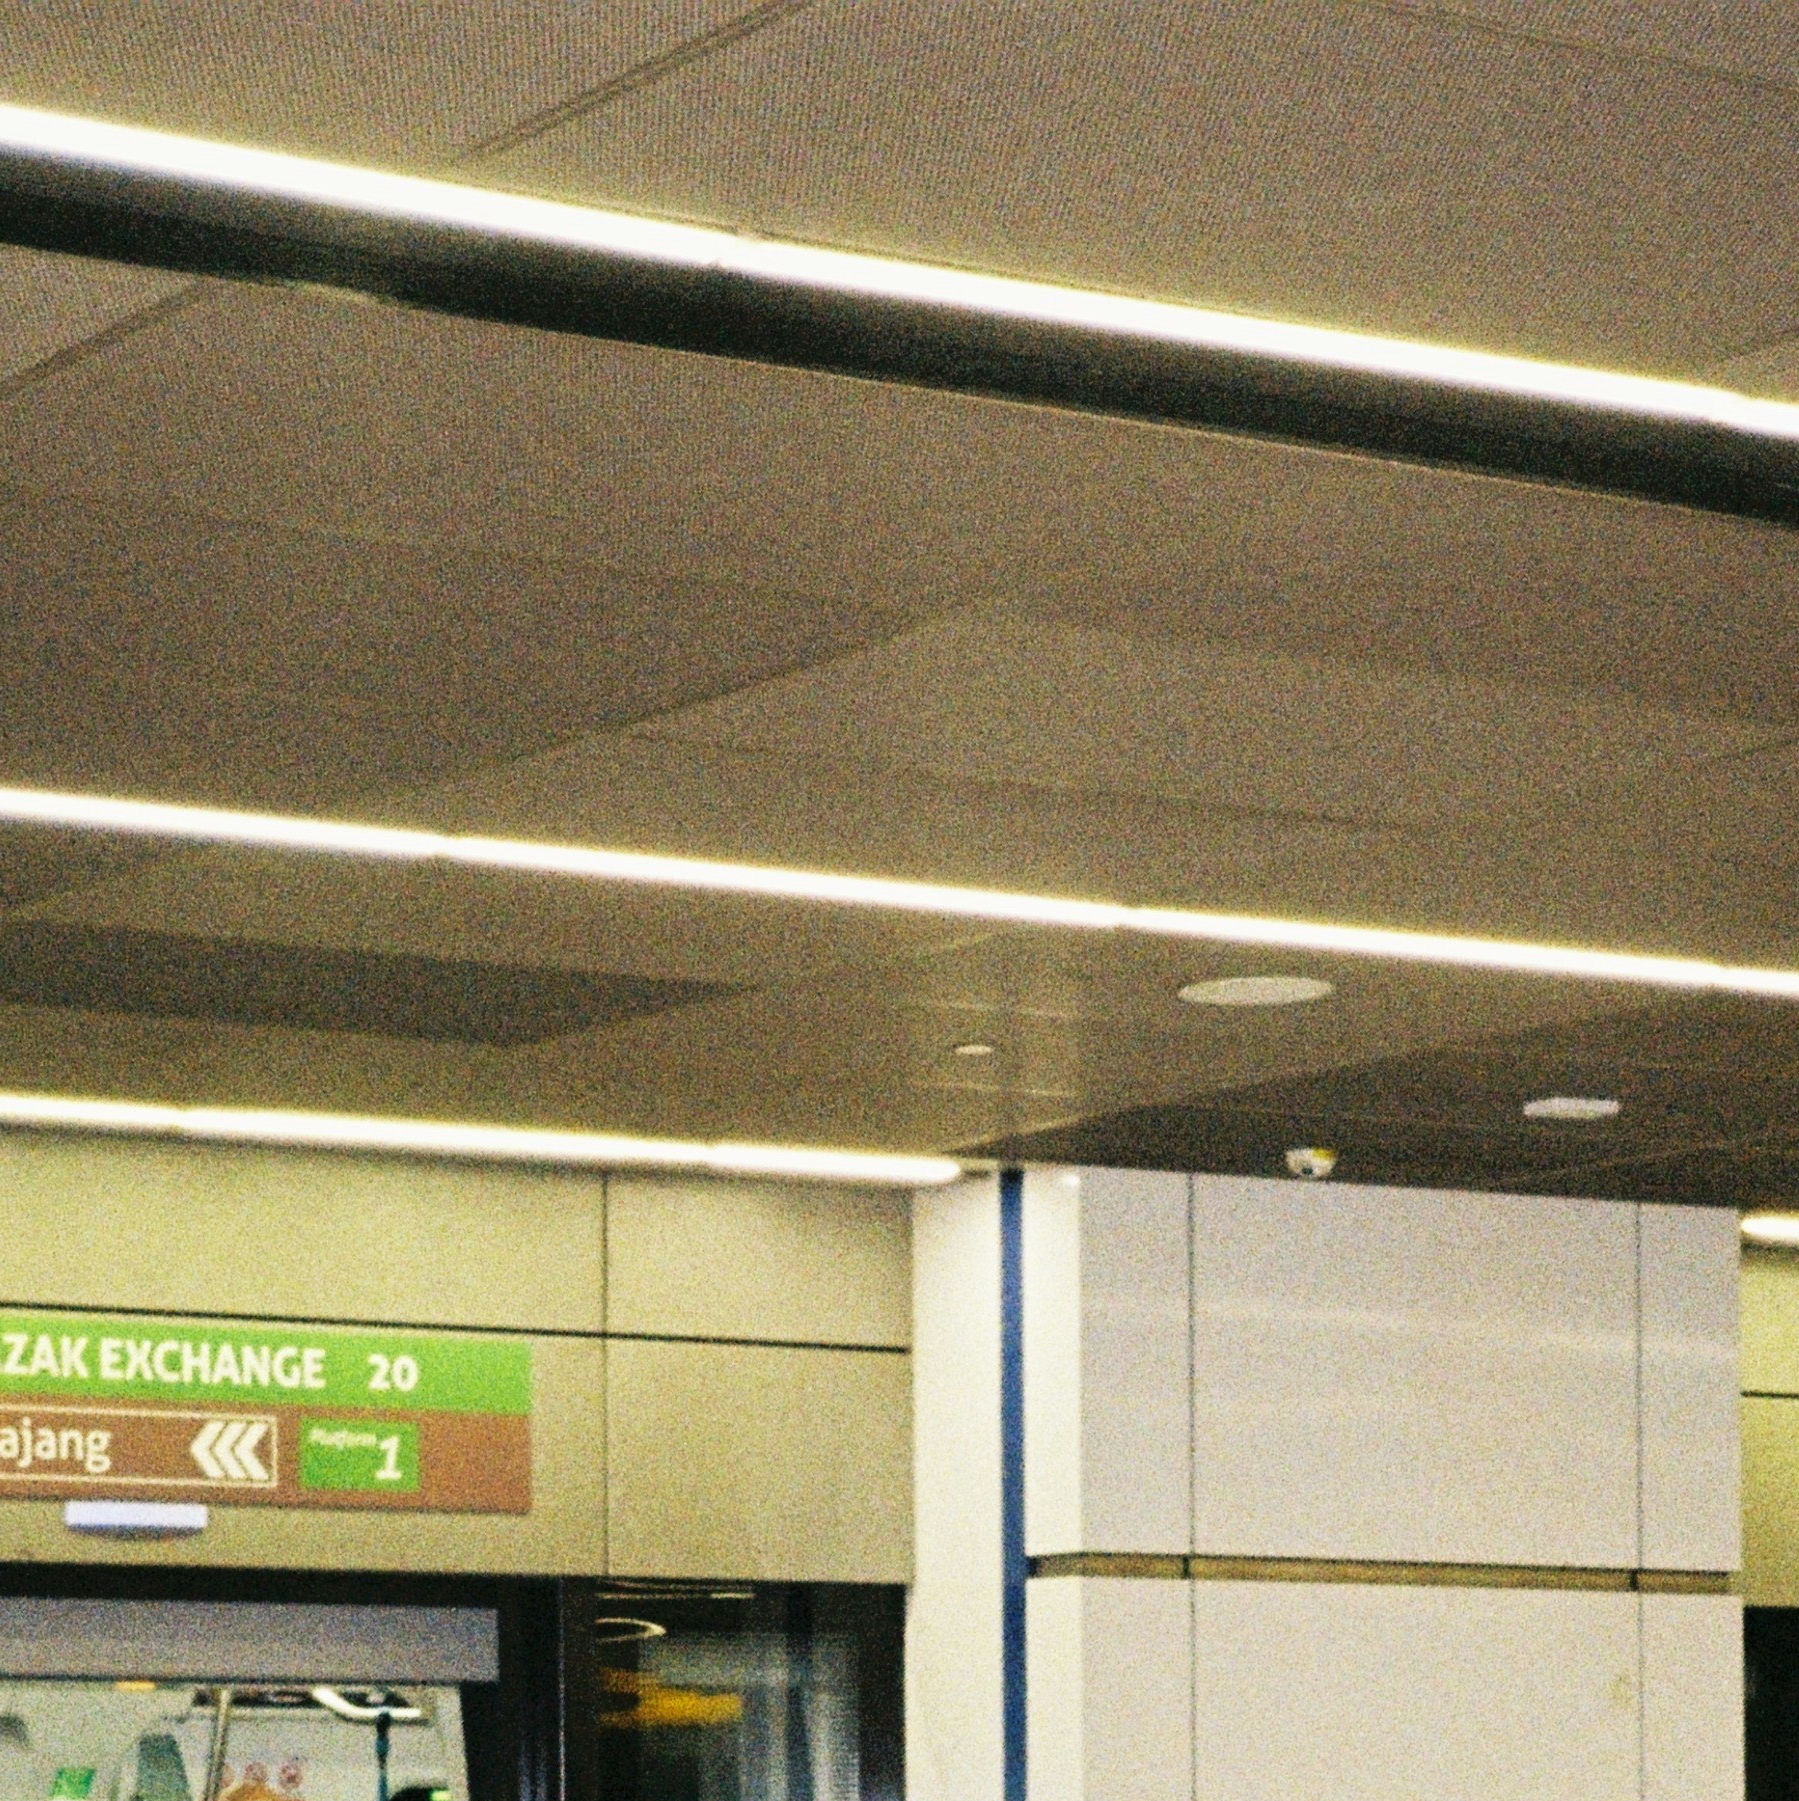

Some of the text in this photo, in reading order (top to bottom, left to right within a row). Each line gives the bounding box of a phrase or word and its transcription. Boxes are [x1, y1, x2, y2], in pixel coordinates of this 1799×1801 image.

[99, 1336, 326, 1390] EXCHANGE
[367, 1352, 419, 1393] 20
[374, 1434, 403, 1482] 1
